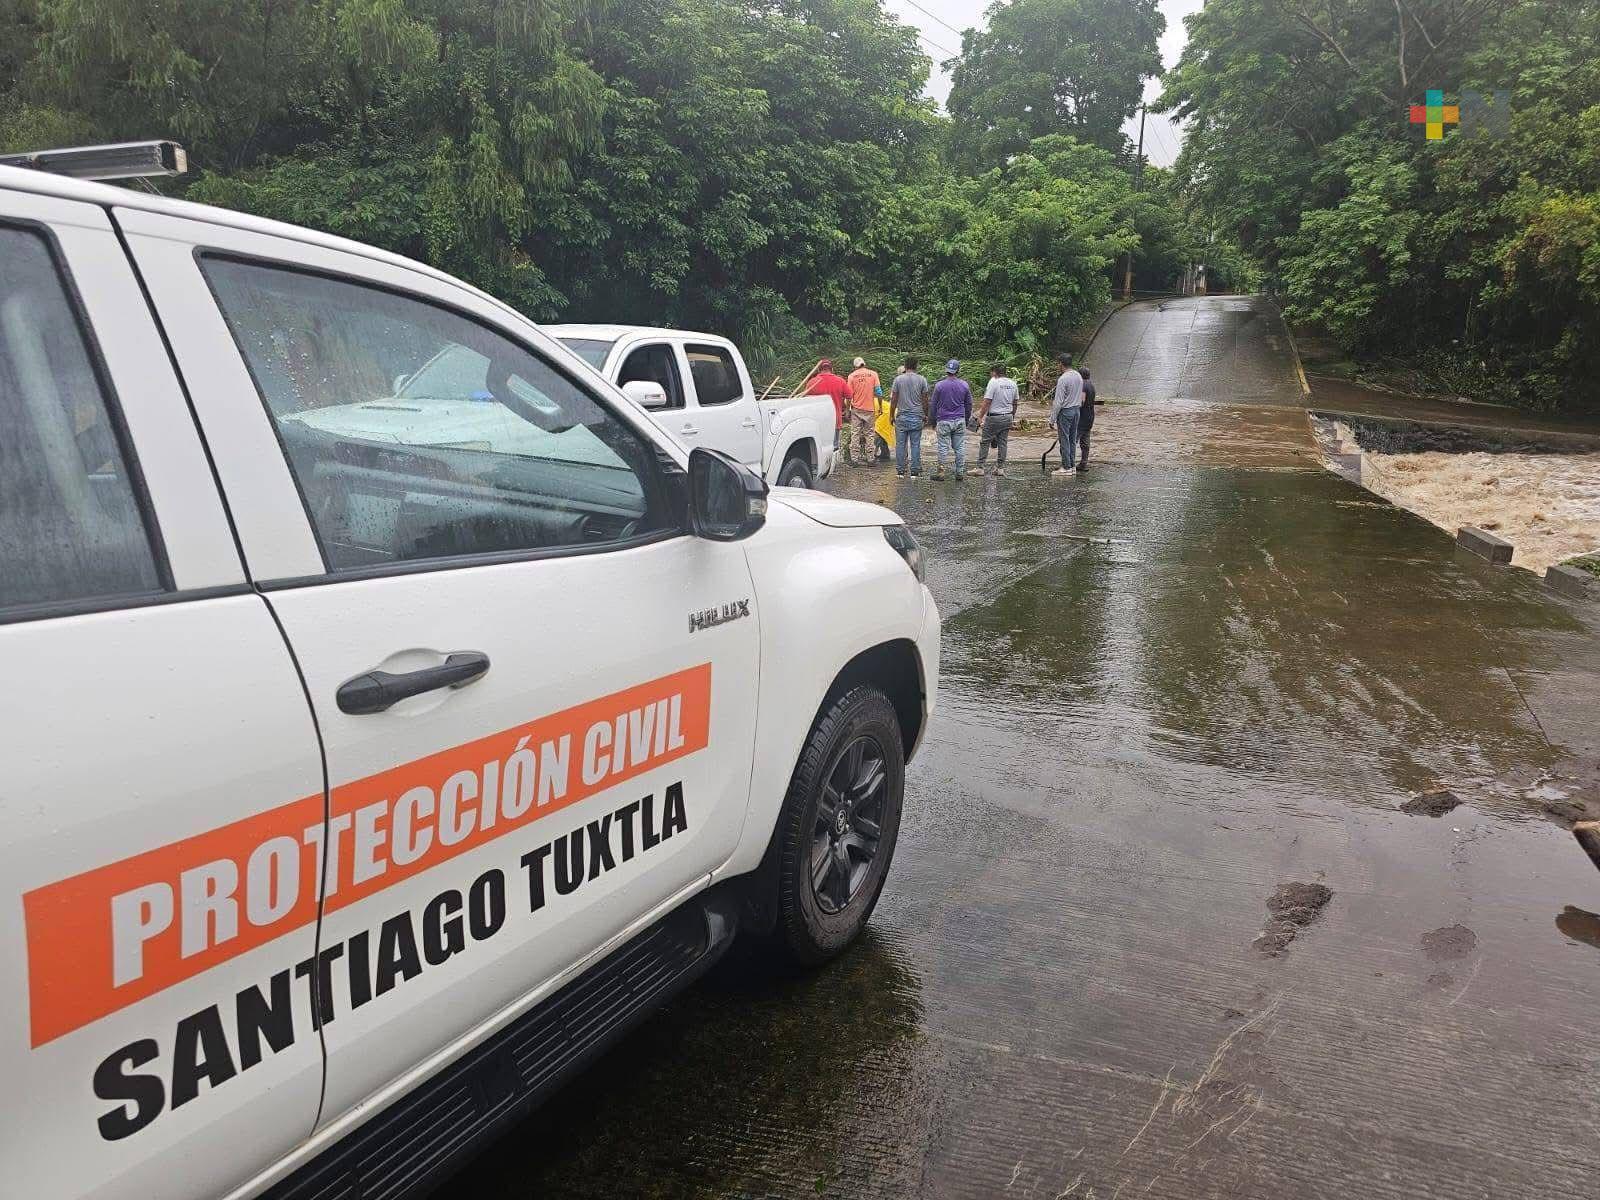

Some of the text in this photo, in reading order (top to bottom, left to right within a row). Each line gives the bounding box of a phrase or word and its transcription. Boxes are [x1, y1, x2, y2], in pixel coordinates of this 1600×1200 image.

[689, 599, 750, 633] HILUX
[93, 781, 688, 1140] SANTIAGO TUXTLA
[111, 694, 685, 988] PROTECCIÓN CIVIL
